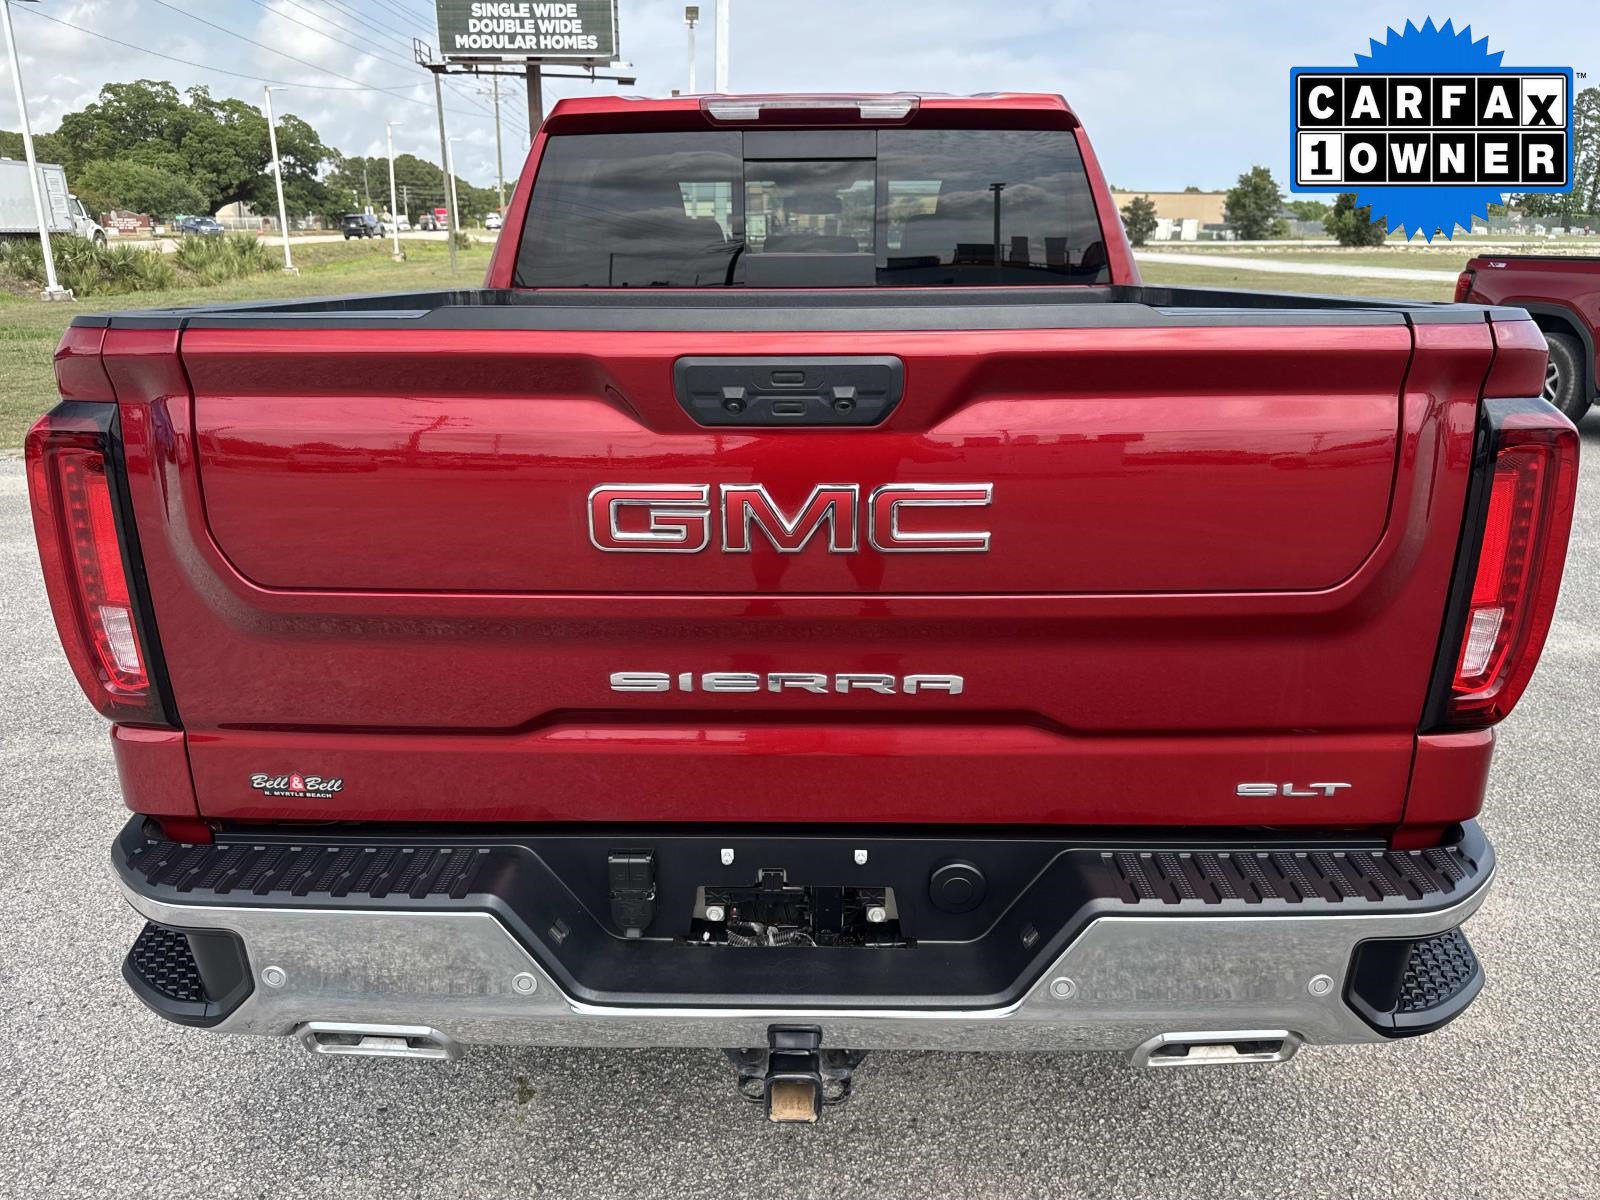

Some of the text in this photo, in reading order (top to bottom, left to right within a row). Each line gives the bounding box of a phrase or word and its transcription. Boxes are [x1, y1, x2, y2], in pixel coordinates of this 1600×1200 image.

[471, 3, 577, 17] SINGLE WIDE
[468, 19, 582, 33] DOUBLE WIDE
[455, 34, 598, 50] MODULAR HOMES
[587, 483, 994, 554] GMC
[610, 672, 964, 694] SIERRA
[251, 774, 343, 791] Bell & Bell
[1236, 782, 1352, 797] SLT
